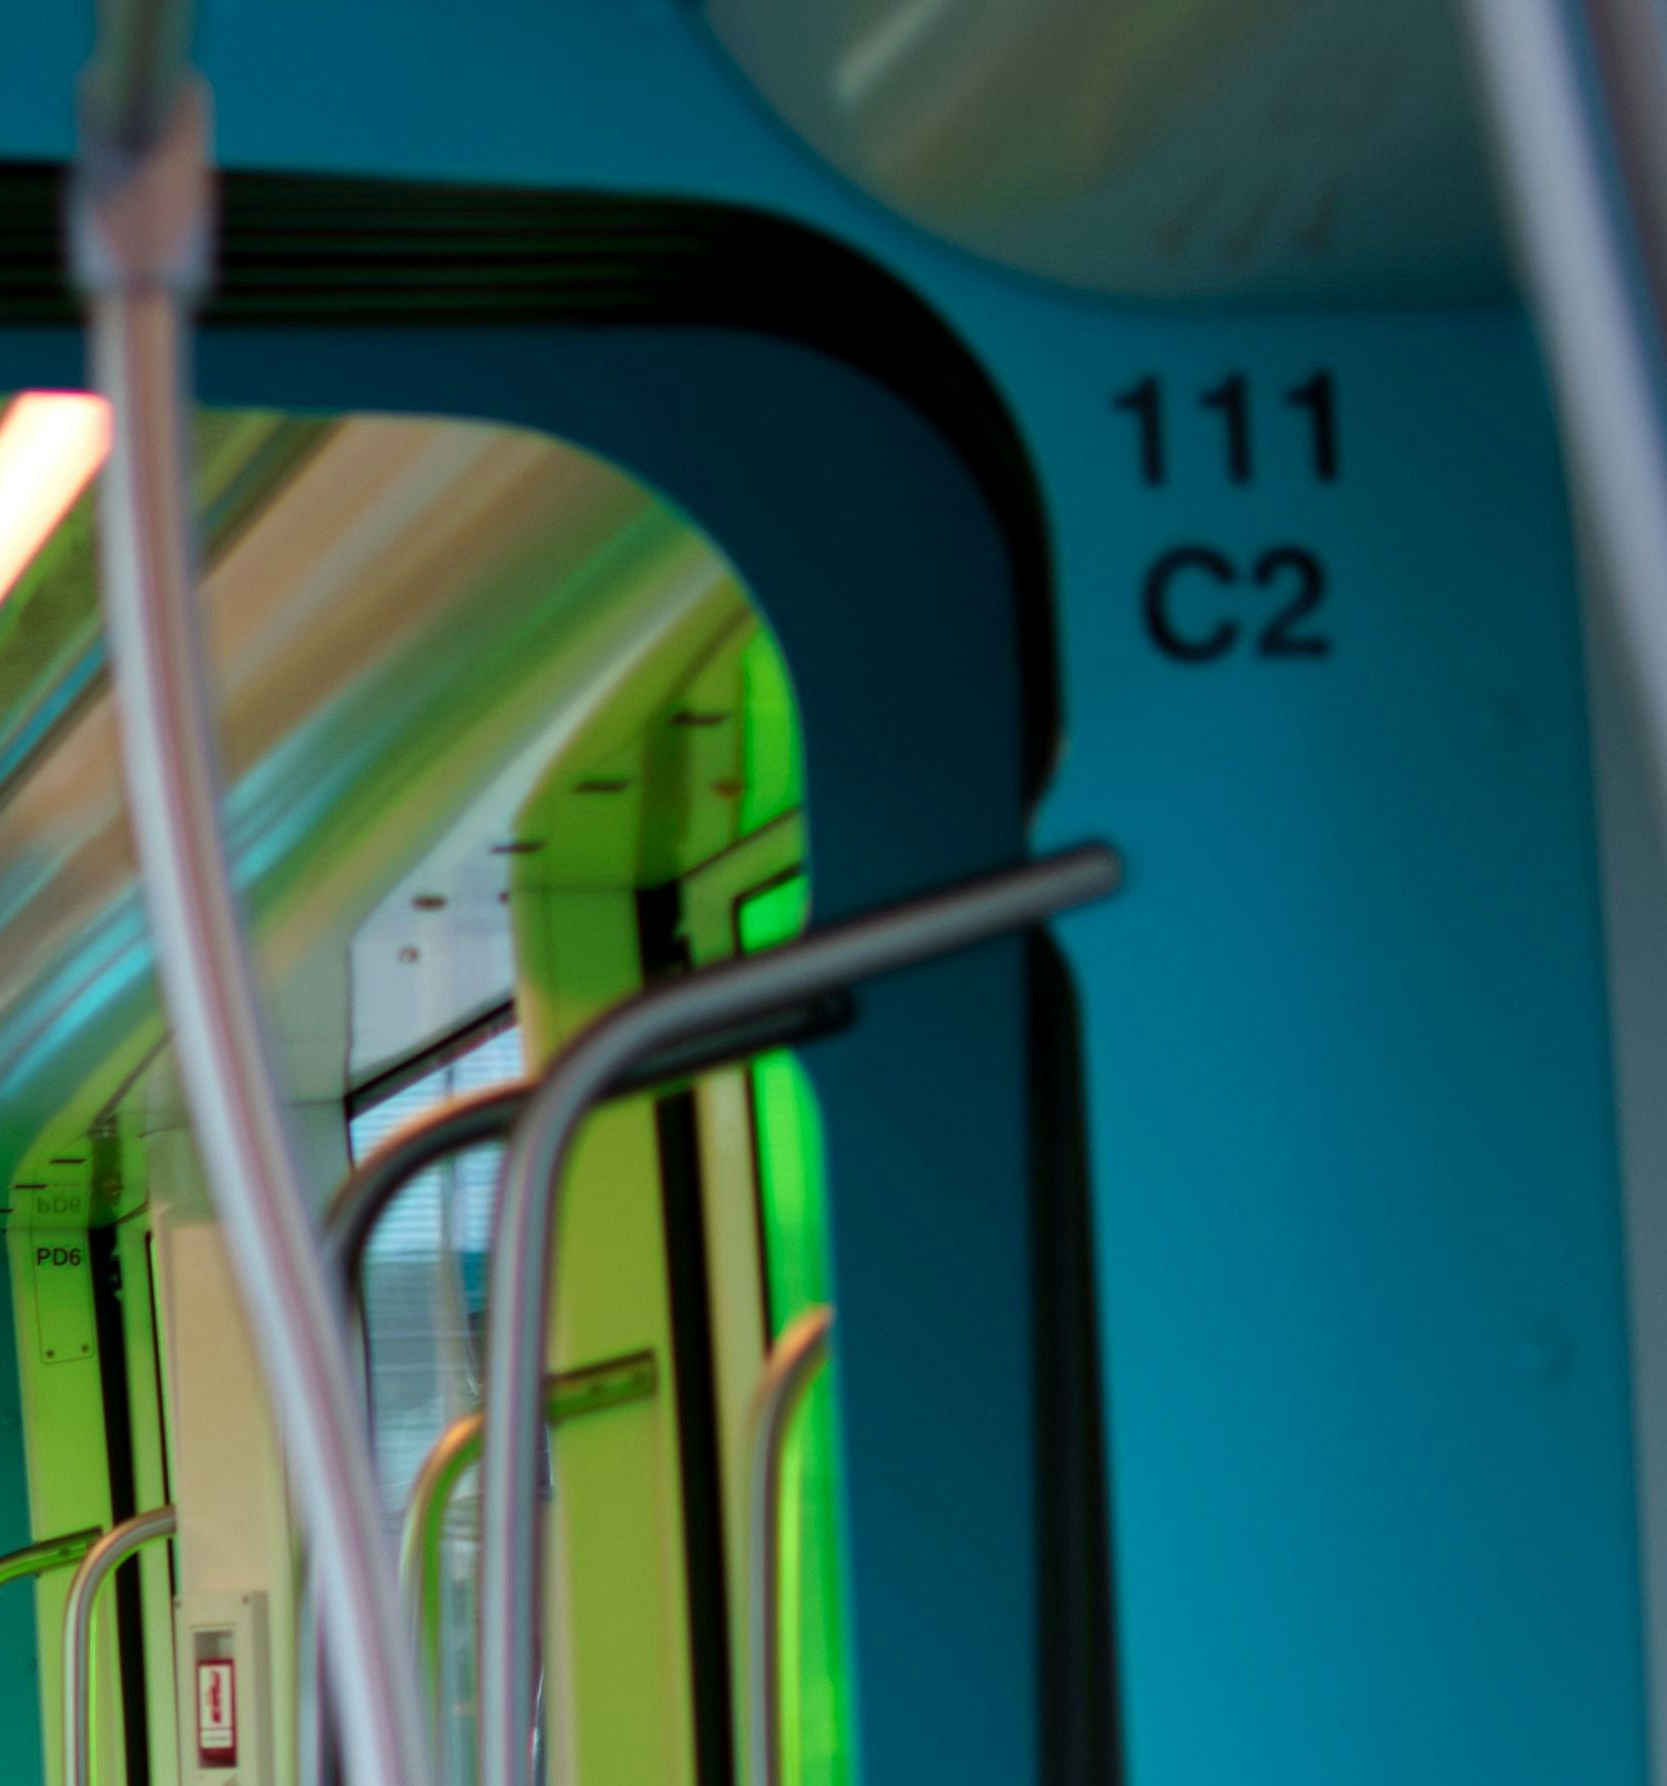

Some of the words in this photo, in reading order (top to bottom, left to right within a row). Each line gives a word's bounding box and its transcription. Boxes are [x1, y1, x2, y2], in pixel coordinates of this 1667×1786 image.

[1112, 370, 1336, 487] 111
[1141, 546, 1331, 664] C2
[36, 1248, 82, 1266] PD6
